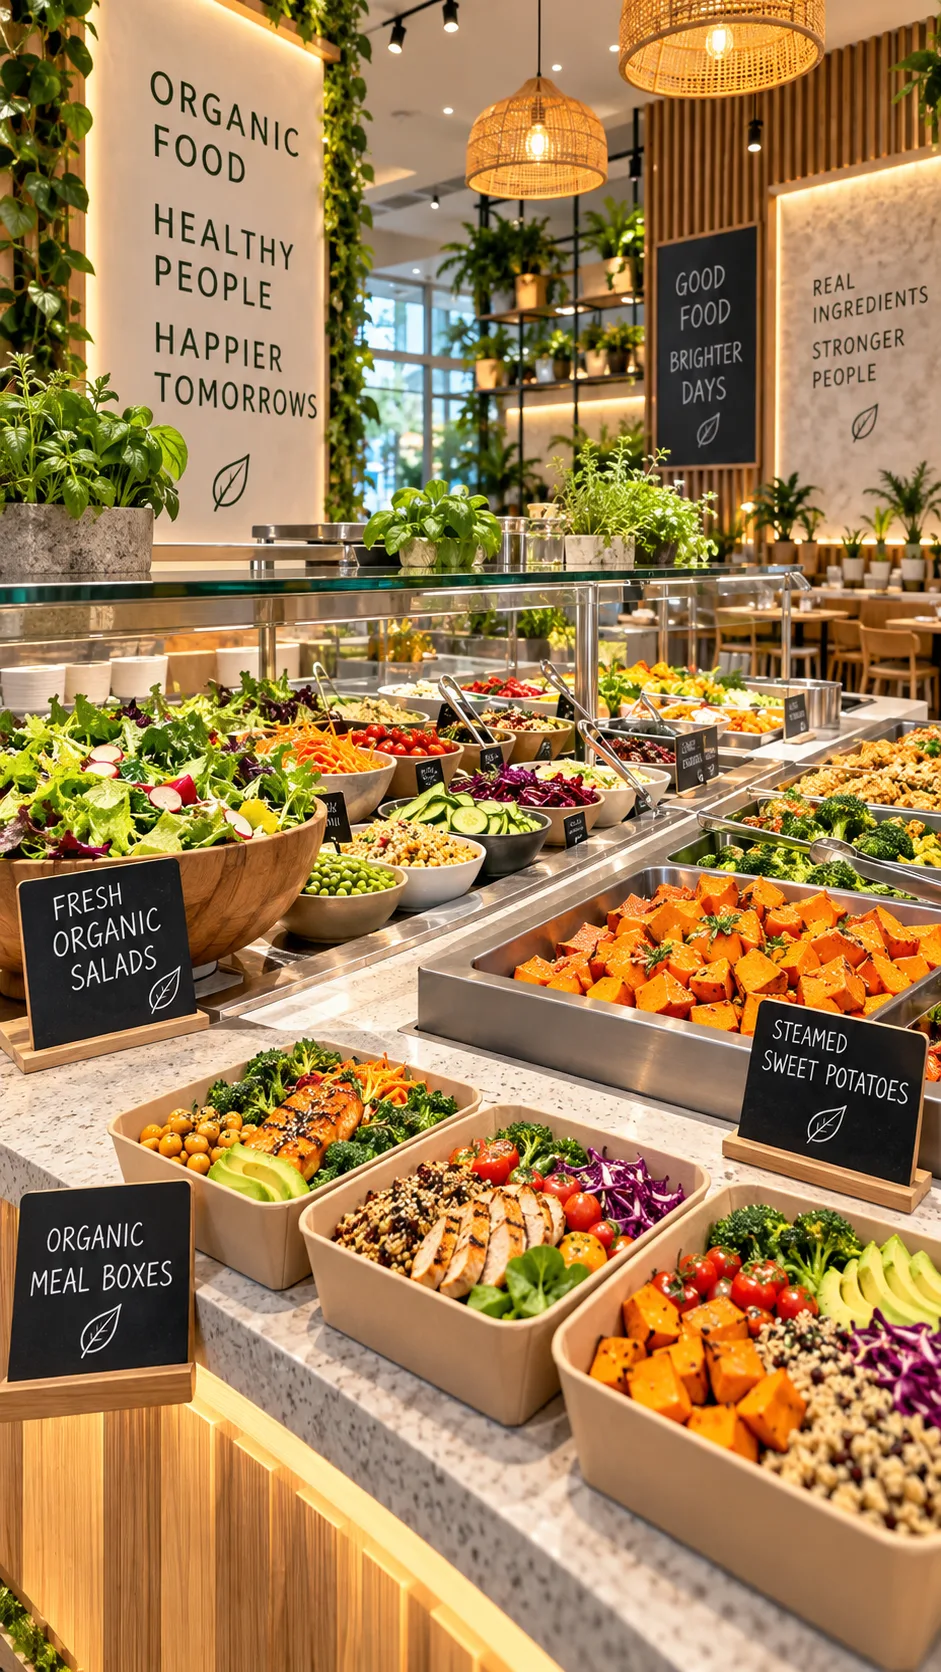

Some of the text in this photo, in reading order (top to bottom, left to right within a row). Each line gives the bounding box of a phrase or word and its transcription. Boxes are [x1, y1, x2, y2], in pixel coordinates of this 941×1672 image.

[150, 70, 300, 157] ORGANIC
[154, 123, 246, 184] FOOD
[154, 203, 294, 271] HEALTHY
[155, 254, 272, 311] PEOPLE
[675, 265, 726, 296] GOOD
[813, 273, 855, 297] REAL
[680, 298, 731, 331] FOOD
[813, 286, 929, 324] INGREDIENTS
[155, 321, 283, 374] HAPPIER
[670, 341, 743, 373] BRIGHTER
[812, 328, 905, 360] STRONGER
[154, 371, 318, 419] TOMORROWS
[682, 376, 727, 405] DAYS
[813, 363, 877, 389] PEOPLE
[53, 882, 123, 921] FRESH
[53, 907, 162, 958] ORGANIC
[71, 945, 157, 991] SALADS
[772, 1019, 848, 1054] STEAMED
[761, 1050, 909, 1105] SWEET POTATOES
[47, 1222, 144, 1253] ORGANIC
[30, 1260, 173, 1297] MEAL BOXES
